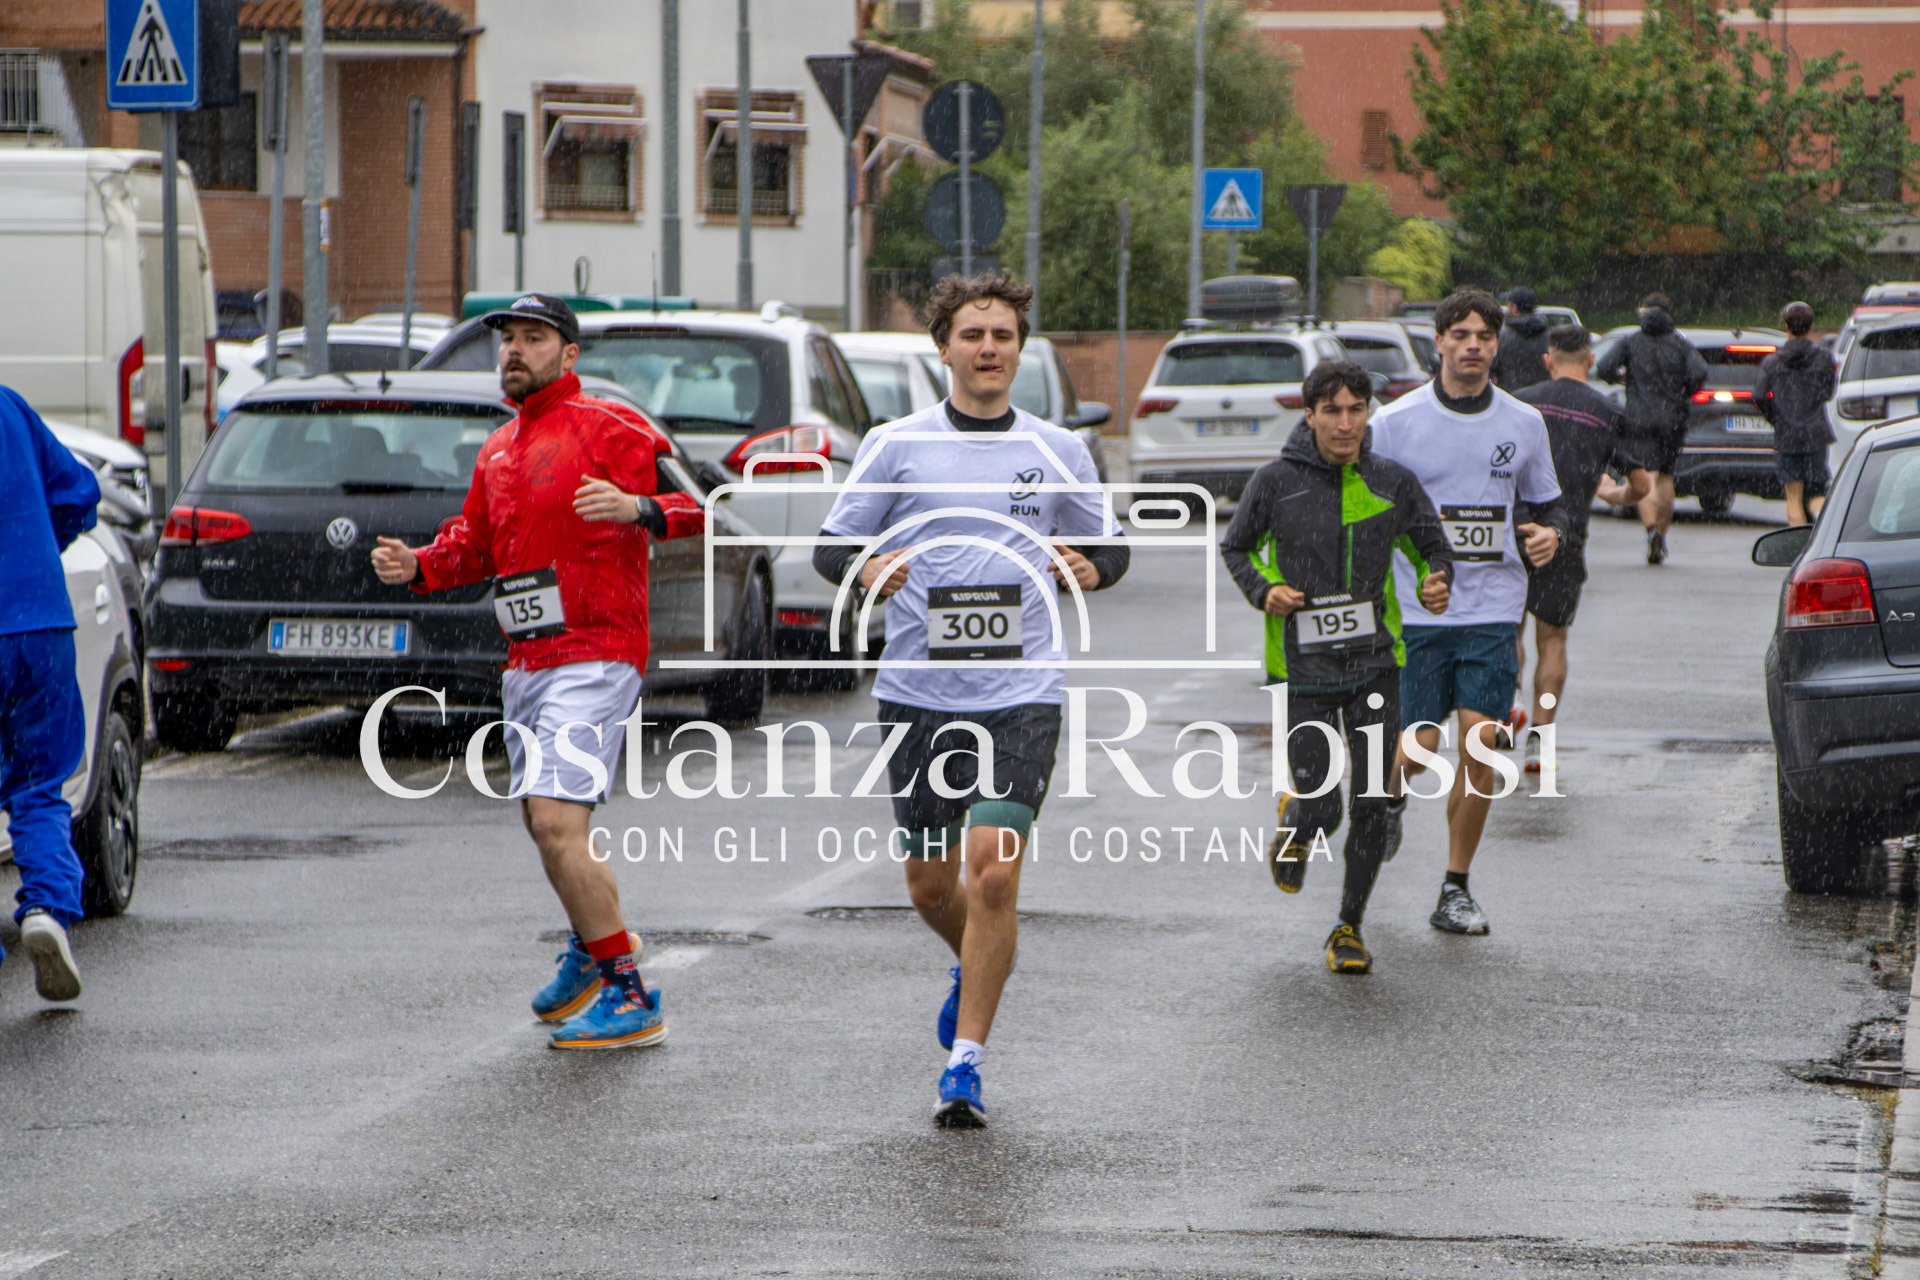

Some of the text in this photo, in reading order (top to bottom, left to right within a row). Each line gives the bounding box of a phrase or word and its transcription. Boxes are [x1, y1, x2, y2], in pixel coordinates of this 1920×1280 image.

[1490, 470, 1512, 478] RUN
[1010, 505, 1040, 516] RUN
[1454, 526, 1493, 547] 301
[502, 576, 538, 592] KIPRUN
[951, 592, 1000, 602] KIPRUN
[506, 596, 543, 625] 135
[942, 612, 1009, 640] 300
[1312, 610, 1358, 636] 195
[285, 624, 312, 648] FH
